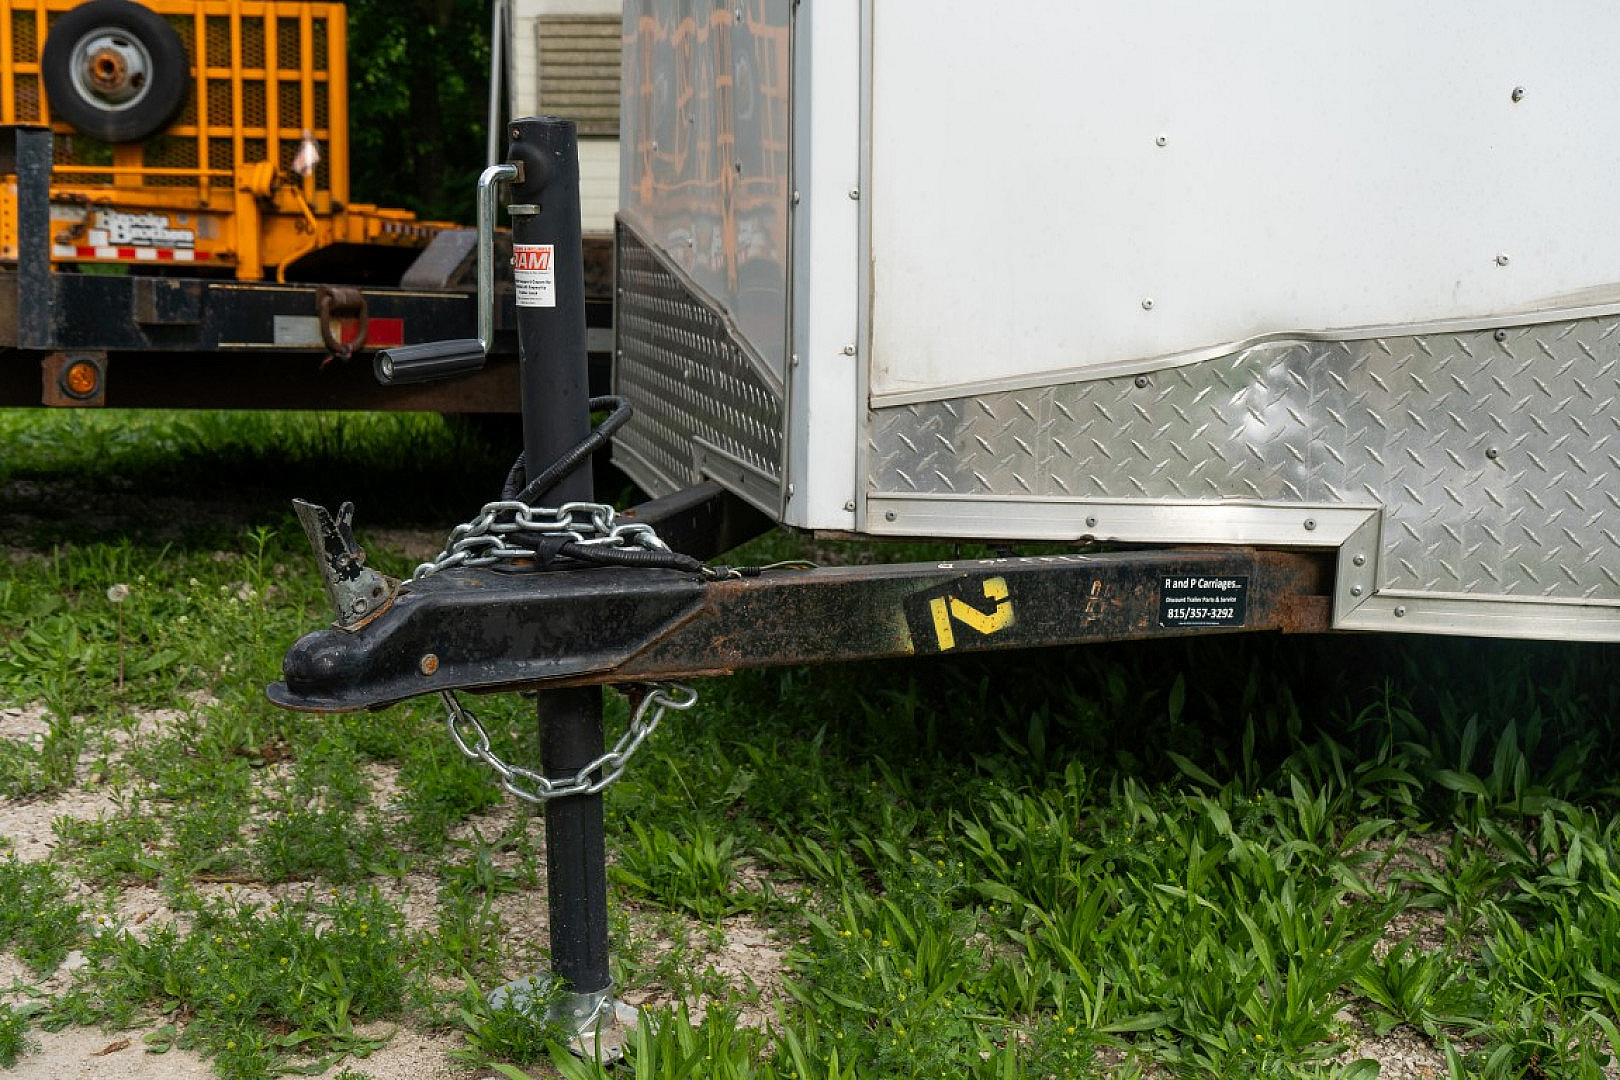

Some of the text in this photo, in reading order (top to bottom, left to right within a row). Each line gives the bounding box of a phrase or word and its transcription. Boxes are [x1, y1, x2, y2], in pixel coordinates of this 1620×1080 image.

[1165, 578, 1171, 589] R
[1172, 578, 1189, 589] and
[1190, 578, 1197, 589] P
[1168, 607, 1233, 619] 815/357-3292
